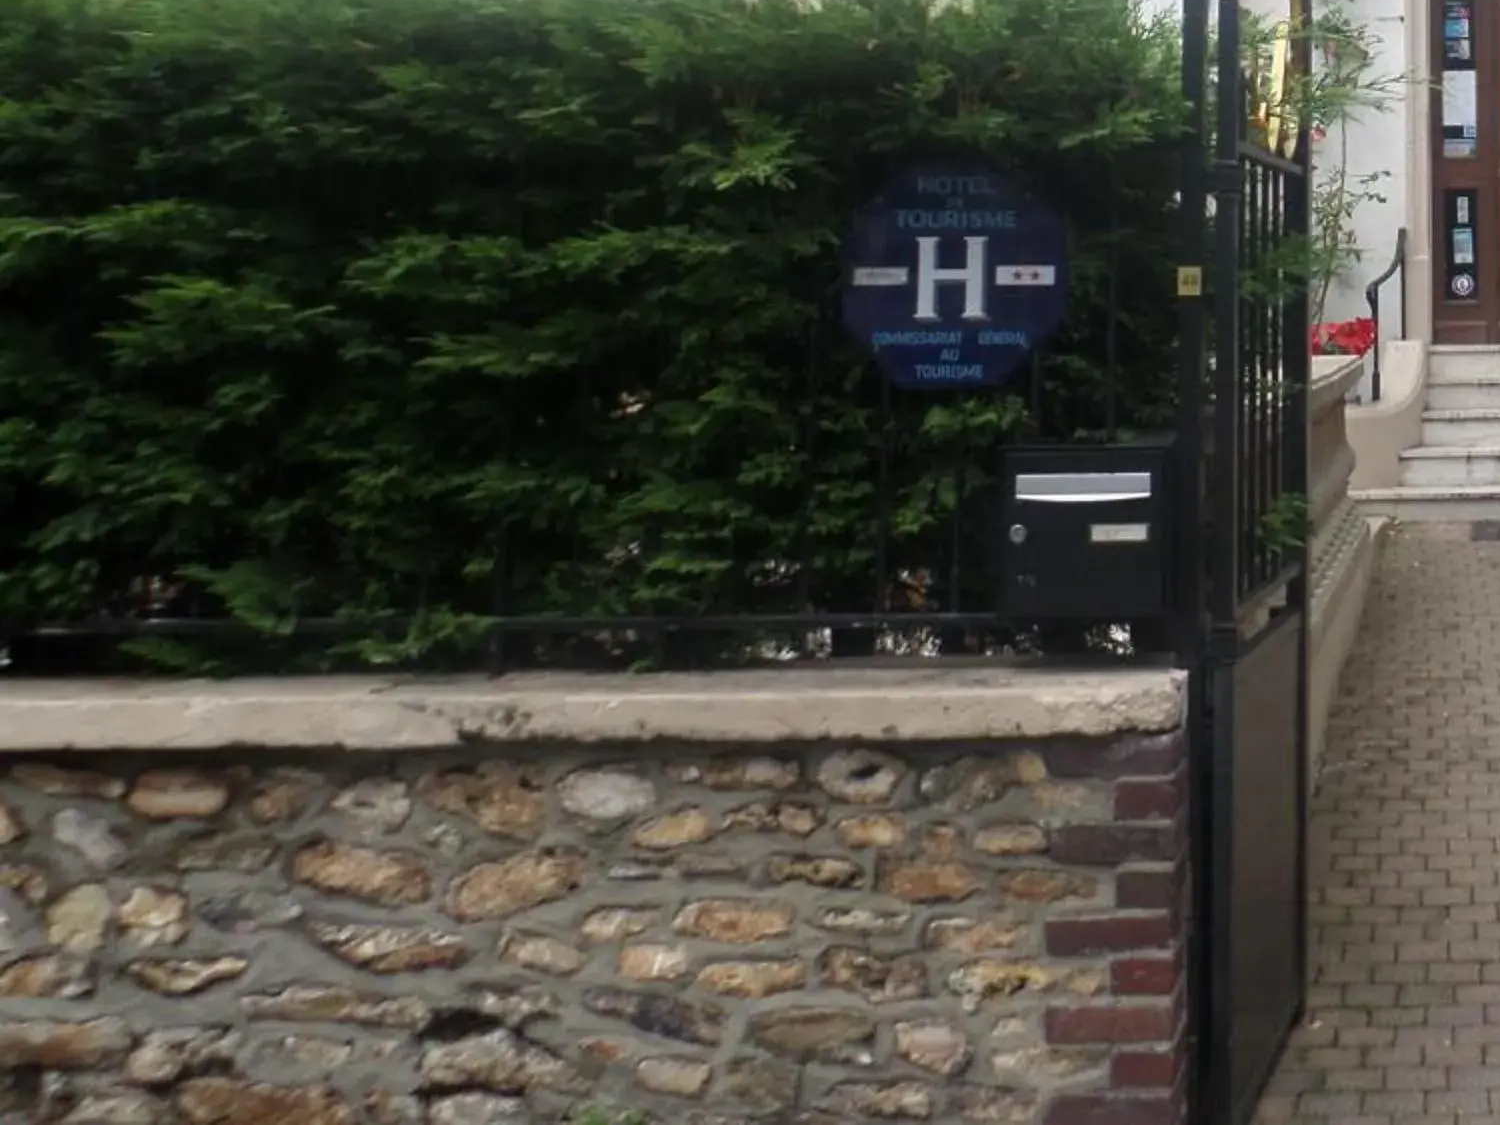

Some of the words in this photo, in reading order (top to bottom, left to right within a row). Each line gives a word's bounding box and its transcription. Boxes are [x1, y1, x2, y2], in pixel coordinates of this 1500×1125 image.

[895, 209, 1017, 228] TOURISME
[913, 236, 989, 319] H
[939, 349, 960, 361] AU
[914, 364, 983, 379] TOURISME
